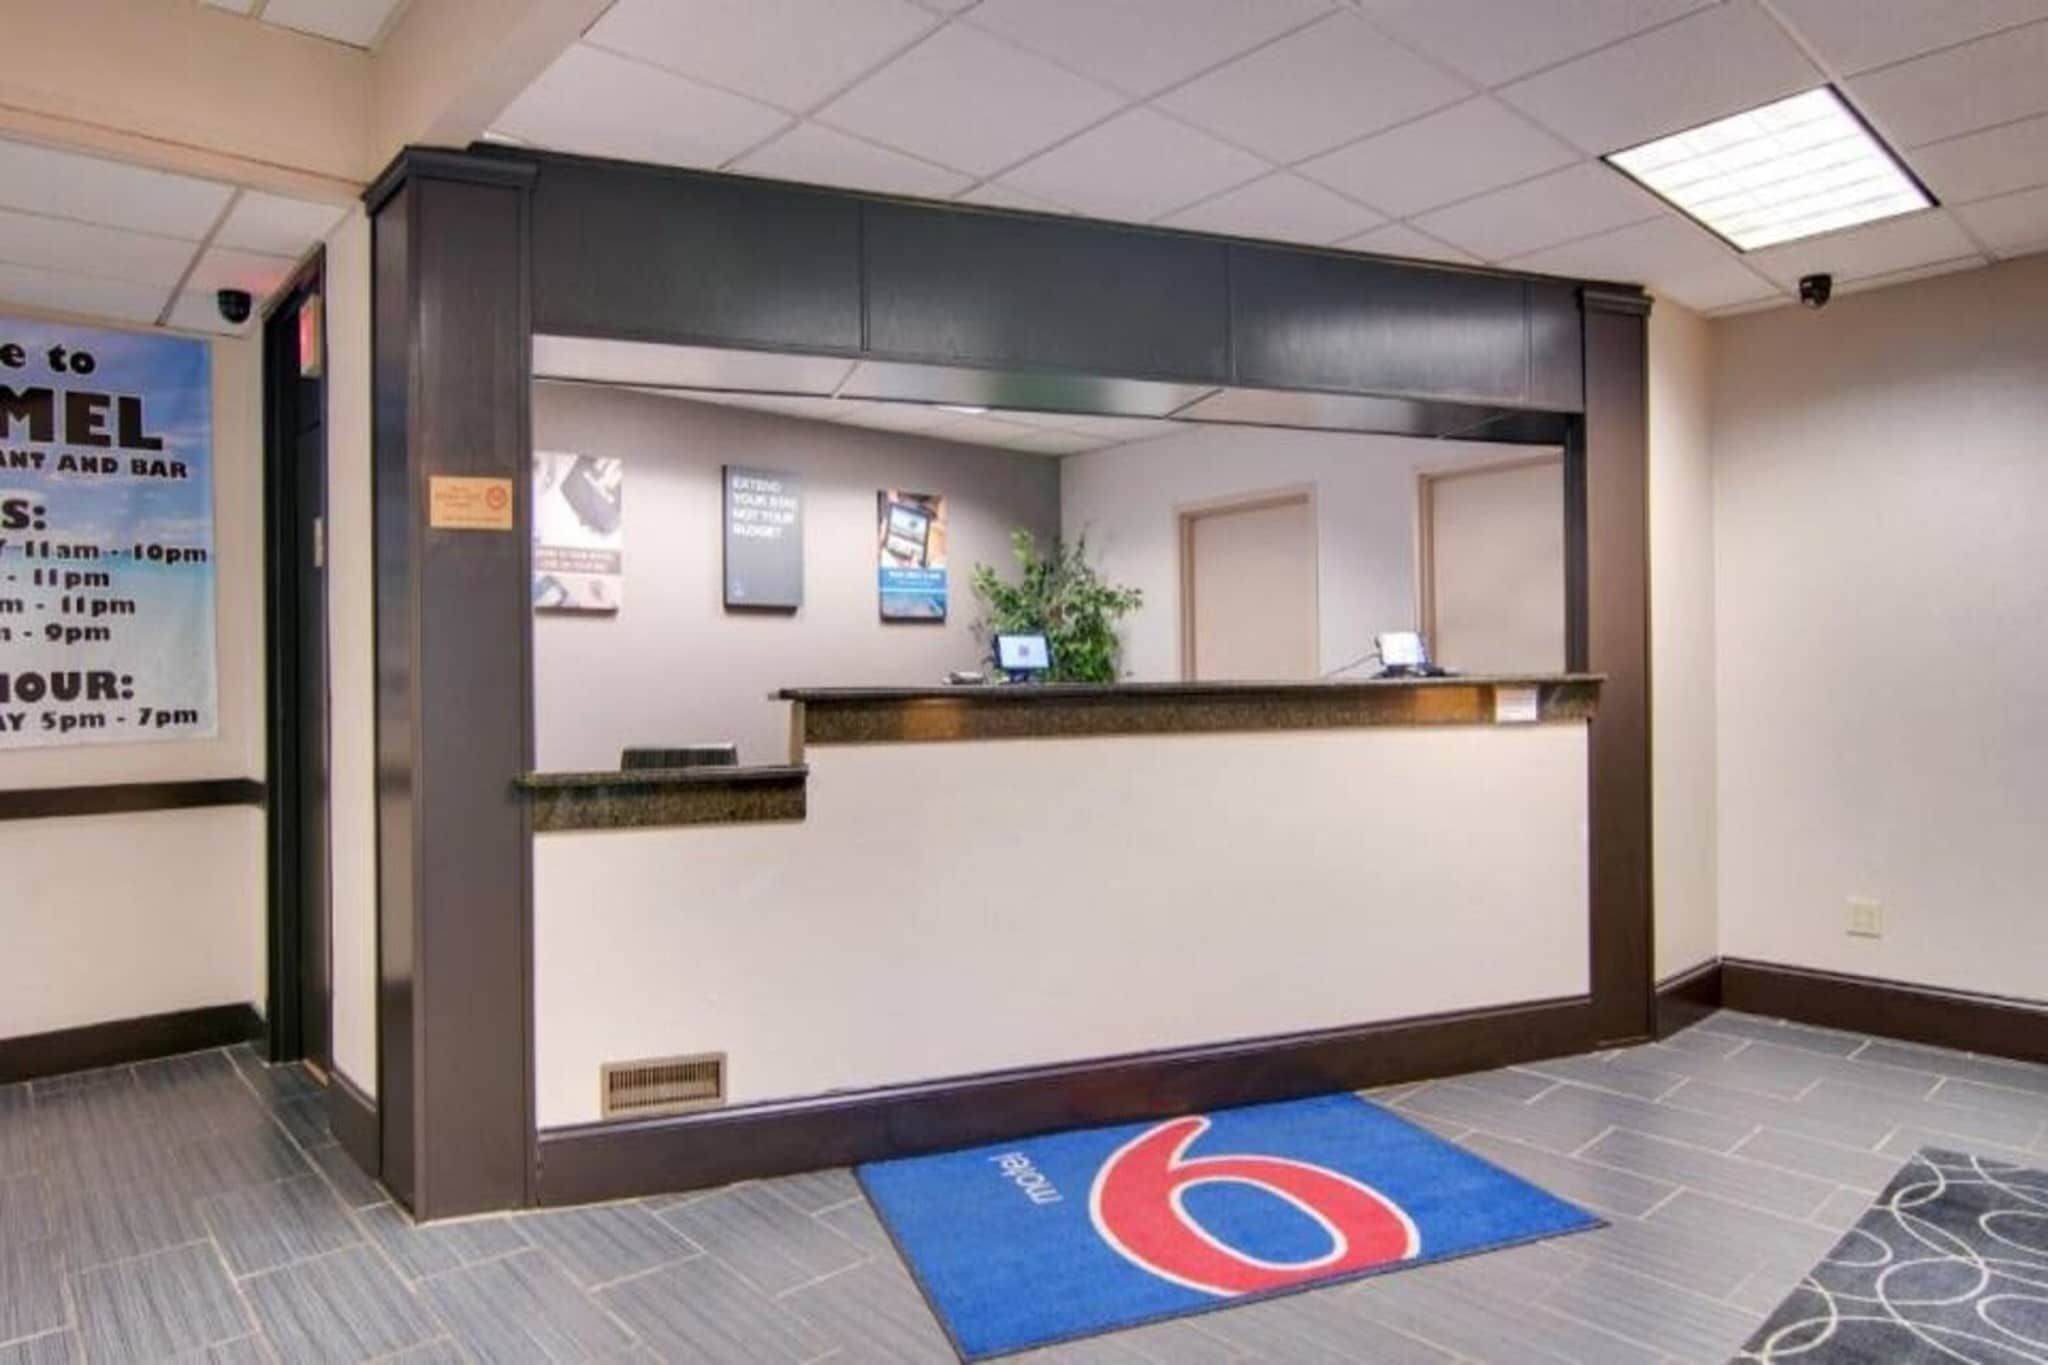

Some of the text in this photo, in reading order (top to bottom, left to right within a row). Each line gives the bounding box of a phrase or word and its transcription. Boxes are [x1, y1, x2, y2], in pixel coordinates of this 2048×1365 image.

[48, 343, 96, 375] to
[0, 385, 163, 450] MEL
[57, 454, 118, 474] AND
[131, 459, 187, 478] BAR
[2, 499, 46, 530] S:
[26, 540, 99, 559] 11am
[134, 543, 207, 563] 10pm
[34, 568, 110, 590] 11pm
[62, 596, 135, 618] 11pm
[45, 623, 110, 645] 9pm
[42, 710, 105, 734] 5pm
[138, 706, 198, 728] 7pm
[988, 1115, 1421, 1297] motel 6
